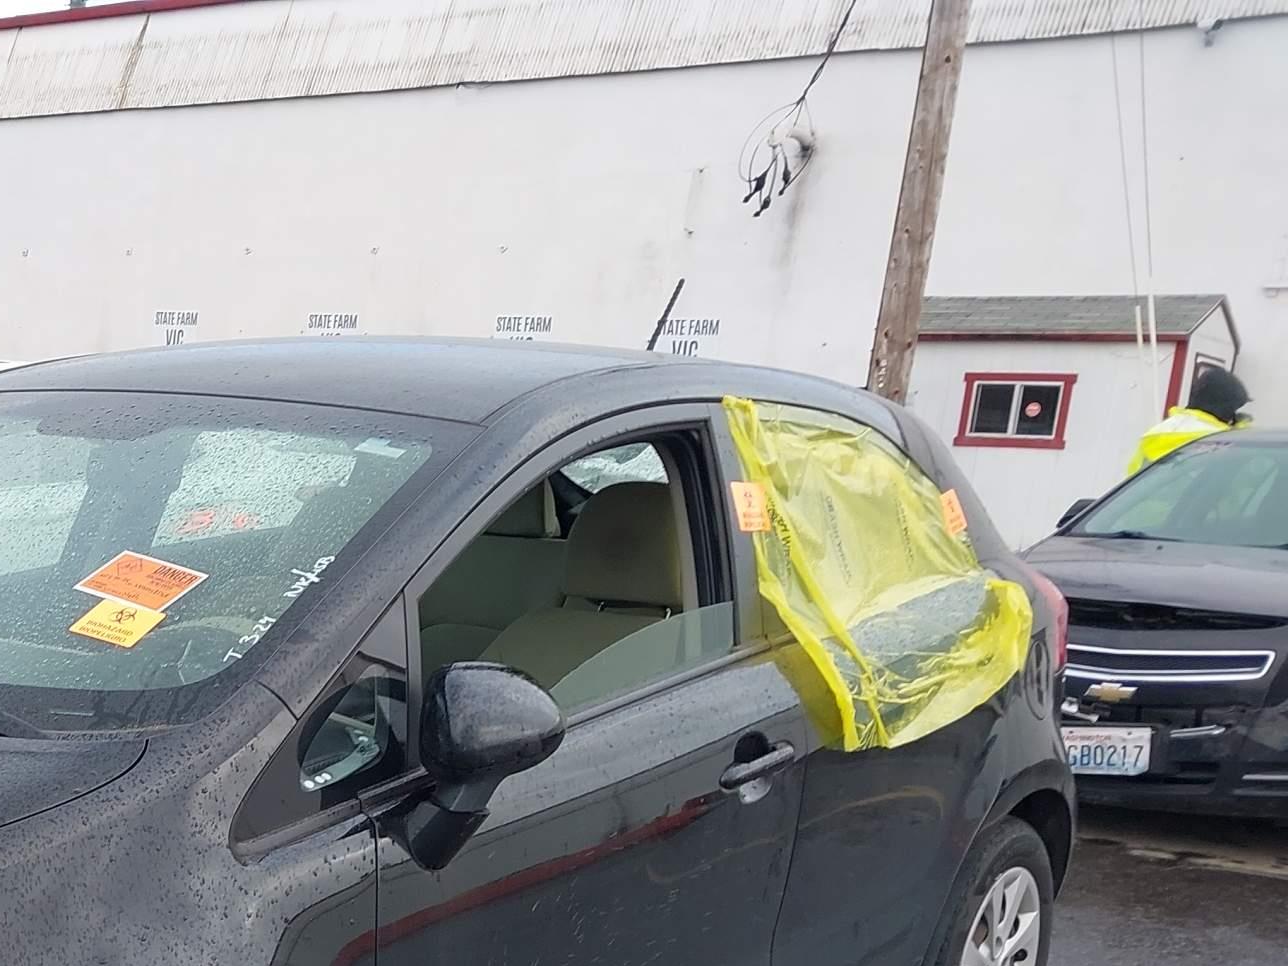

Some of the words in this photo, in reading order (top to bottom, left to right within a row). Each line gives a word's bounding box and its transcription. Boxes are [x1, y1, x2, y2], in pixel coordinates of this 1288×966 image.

[155, 311, 176, 326] STATE
[176, 311, 199, 326] FARM
[308, 314, 332, 329] STATE
[332, 314, 358, 329] FARM
[496, 316, 523, 333] STATE
[523, 316, 552, 333] FARM
[657, 319, 686, 336] TATE
[688, 319, 720, 336] FARM
[165, 329, 185, 346] VIC
[672, 340, 698, 357] VIC
[153, 565, 200, 587] DANGER
